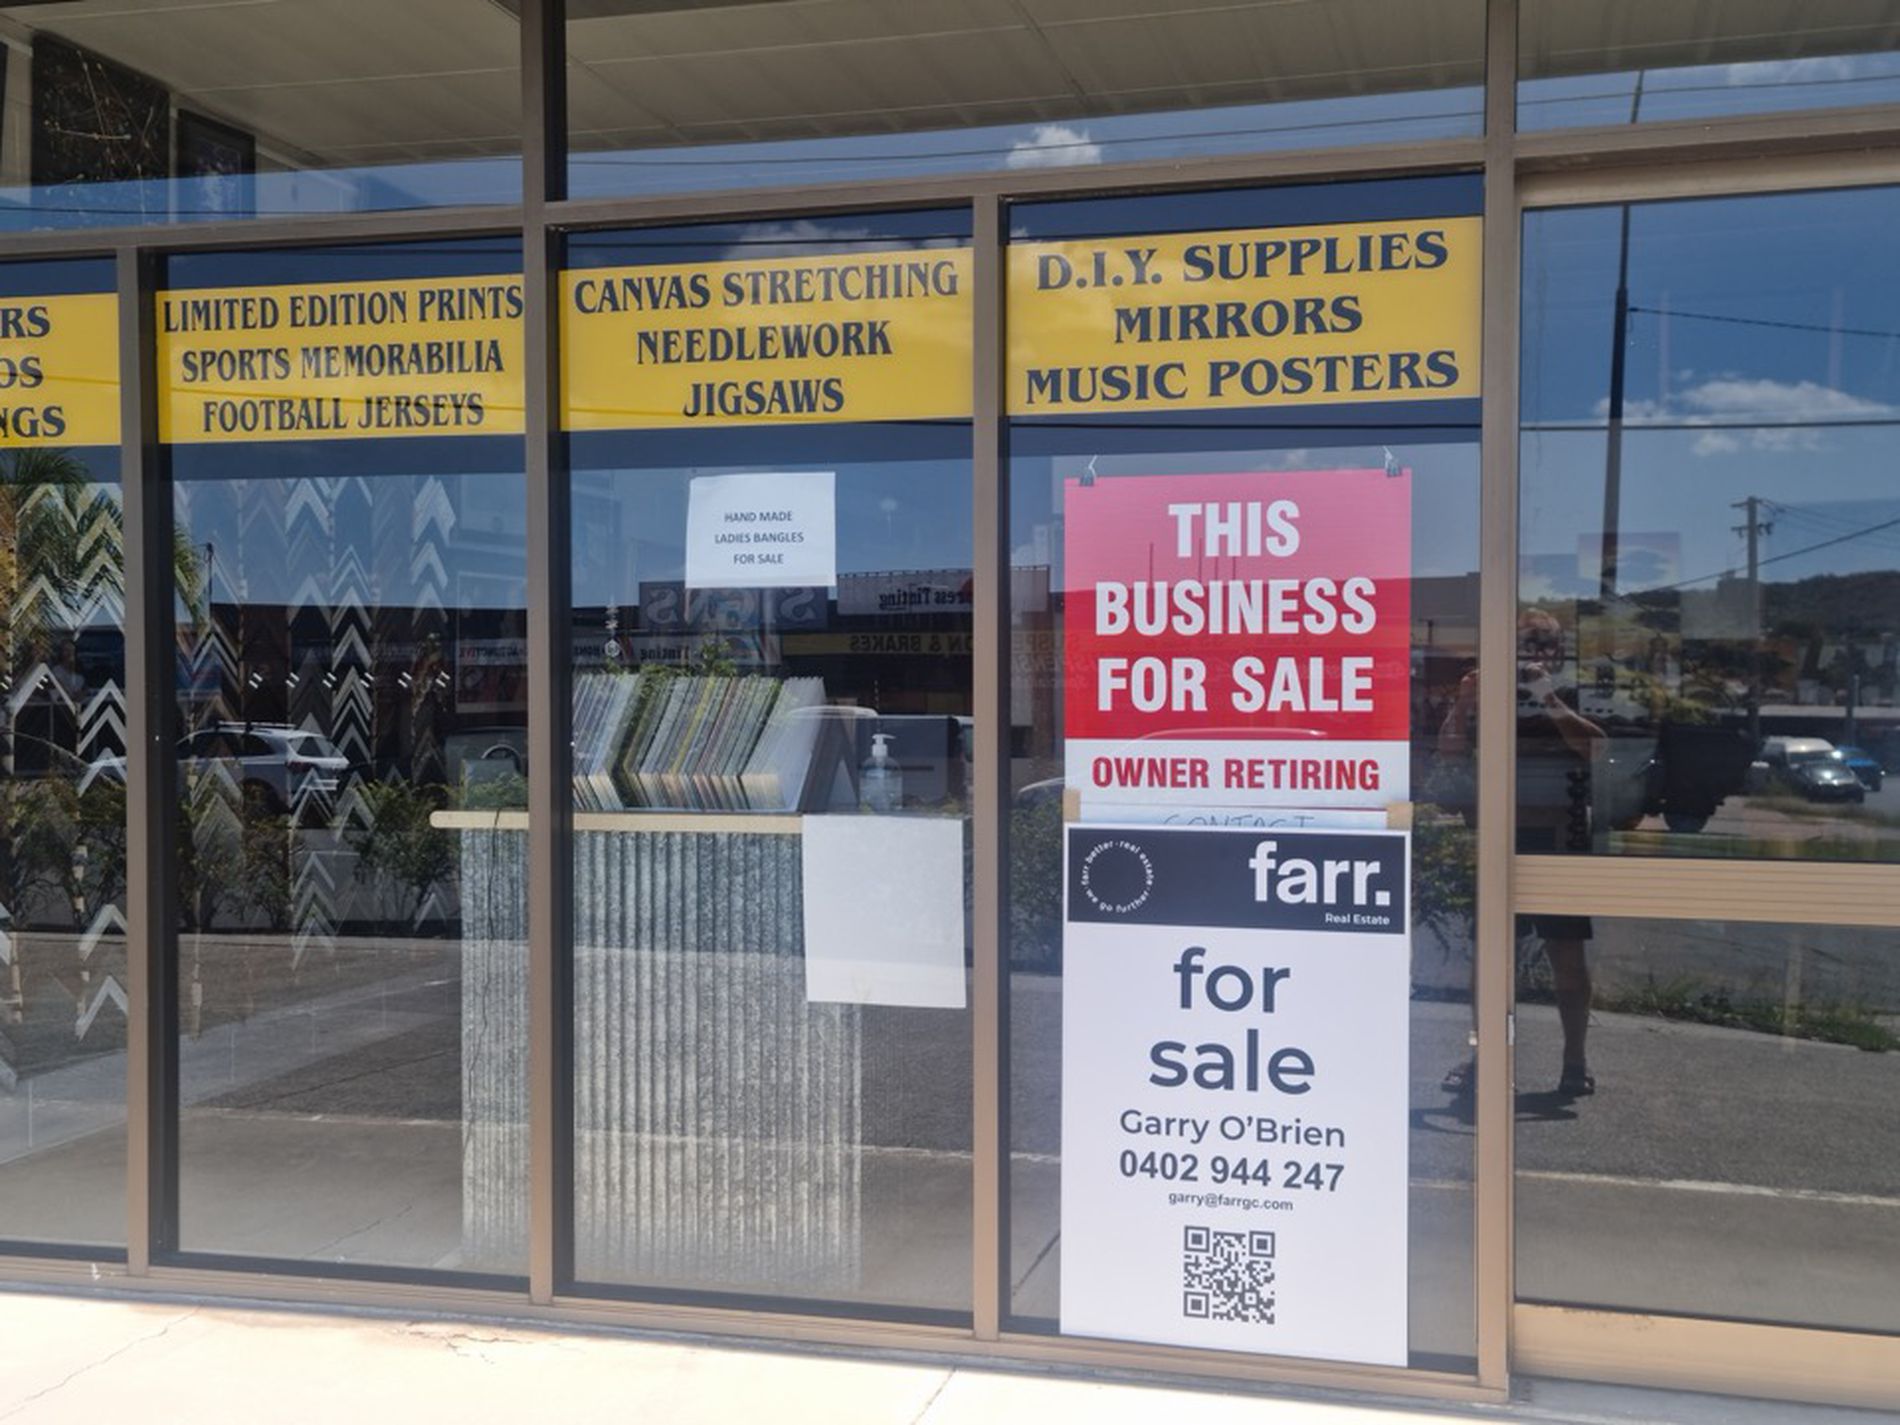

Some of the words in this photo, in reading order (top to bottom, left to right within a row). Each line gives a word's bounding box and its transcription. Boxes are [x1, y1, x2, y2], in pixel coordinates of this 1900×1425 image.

[1037, 248, 1162, 290] D.I.Y.
[1184, 231, 1448, 282] SUPPLIES
[164, 298, 279, 332] LIMITED
[290, 291, 407, 328] EDITION
[419, 285, 523, 322] PRINTS
[574, 273, 711, 314] CANVAS
[722, 260, 959, 307] STRETCHING
[1115, 295, 1363, 344] MIRRORS
[182, 347, 291, 383] SPORTS
[301, 339, 504, 378] MEMORABILIA
[637, 320, 892, 365] NEEDLEWORK
[683, 378, 845, 417] JIGSAWS
[1026, 362, 1188, 404] MUSIC
[1208, 350, 1460, 397] POSTERS
[202, 395, 348, 433] FOOTBALL
[358, 392, 485, 431] JERSEYS
[714, 532, 752, 545] LADIES
[753, 531, 804, 544] BANGLES
[724, 511, 757, 523] HAND
[759, 511, 793, 522] MADE
[1169, 500, 1300, 557] THIS
[733, 553, 756, 565] FOR
[758, 553, 784, 564] SALE
[1095, 577, 1377, 636] BUSINESS
[1098, 656, 1208, 712] FOR
[1231, 656, 1374, 712] SALE
[1092, 757, 1210, 789] OWNER
[1224, 758, 1380, 791] RETIRING
[1249, 840, 1390, 906] farr.
[1325, 913, 1350, 924] Real
[1353, 914, 1390, 926] Estate
[1173, 947, 1290, 1013] for
[1149, 1029, 1315, 1095] sale
[1120, 1109, 1209, 1143] Garry
[1220, 1115, 1345, 1148] O'Brien
[1119, 1149, 1199, 1182] 0402
[1210, 1156, 1272, 1187] 944
[1283, 1160, 1345, 1192] 247
[1168, 1191, 1294, 1211] garry@farrgc.com
